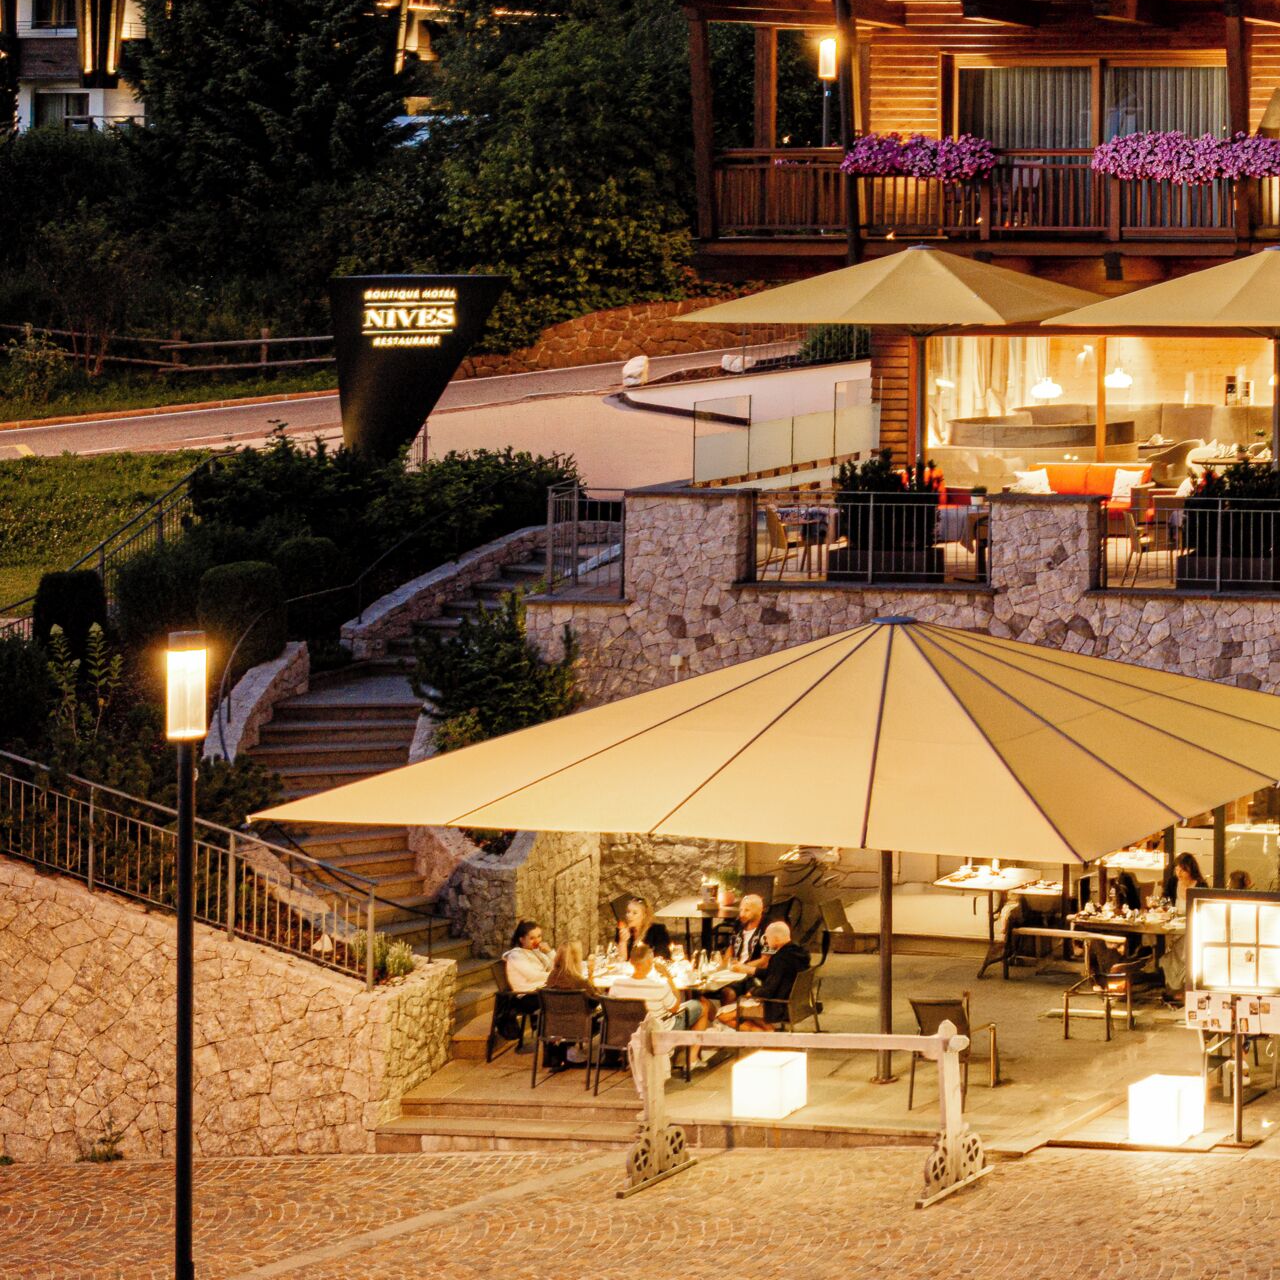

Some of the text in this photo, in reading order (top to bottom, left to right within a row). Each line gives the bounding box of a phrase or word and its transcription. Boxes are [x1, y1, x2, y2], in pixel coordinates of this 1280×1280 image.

[363, 288, 457, 300] BOUTIQUE HOTEL
[362, 307, 456, 328] NIVES
[373, 336, 440, 346] RESTAURANT
